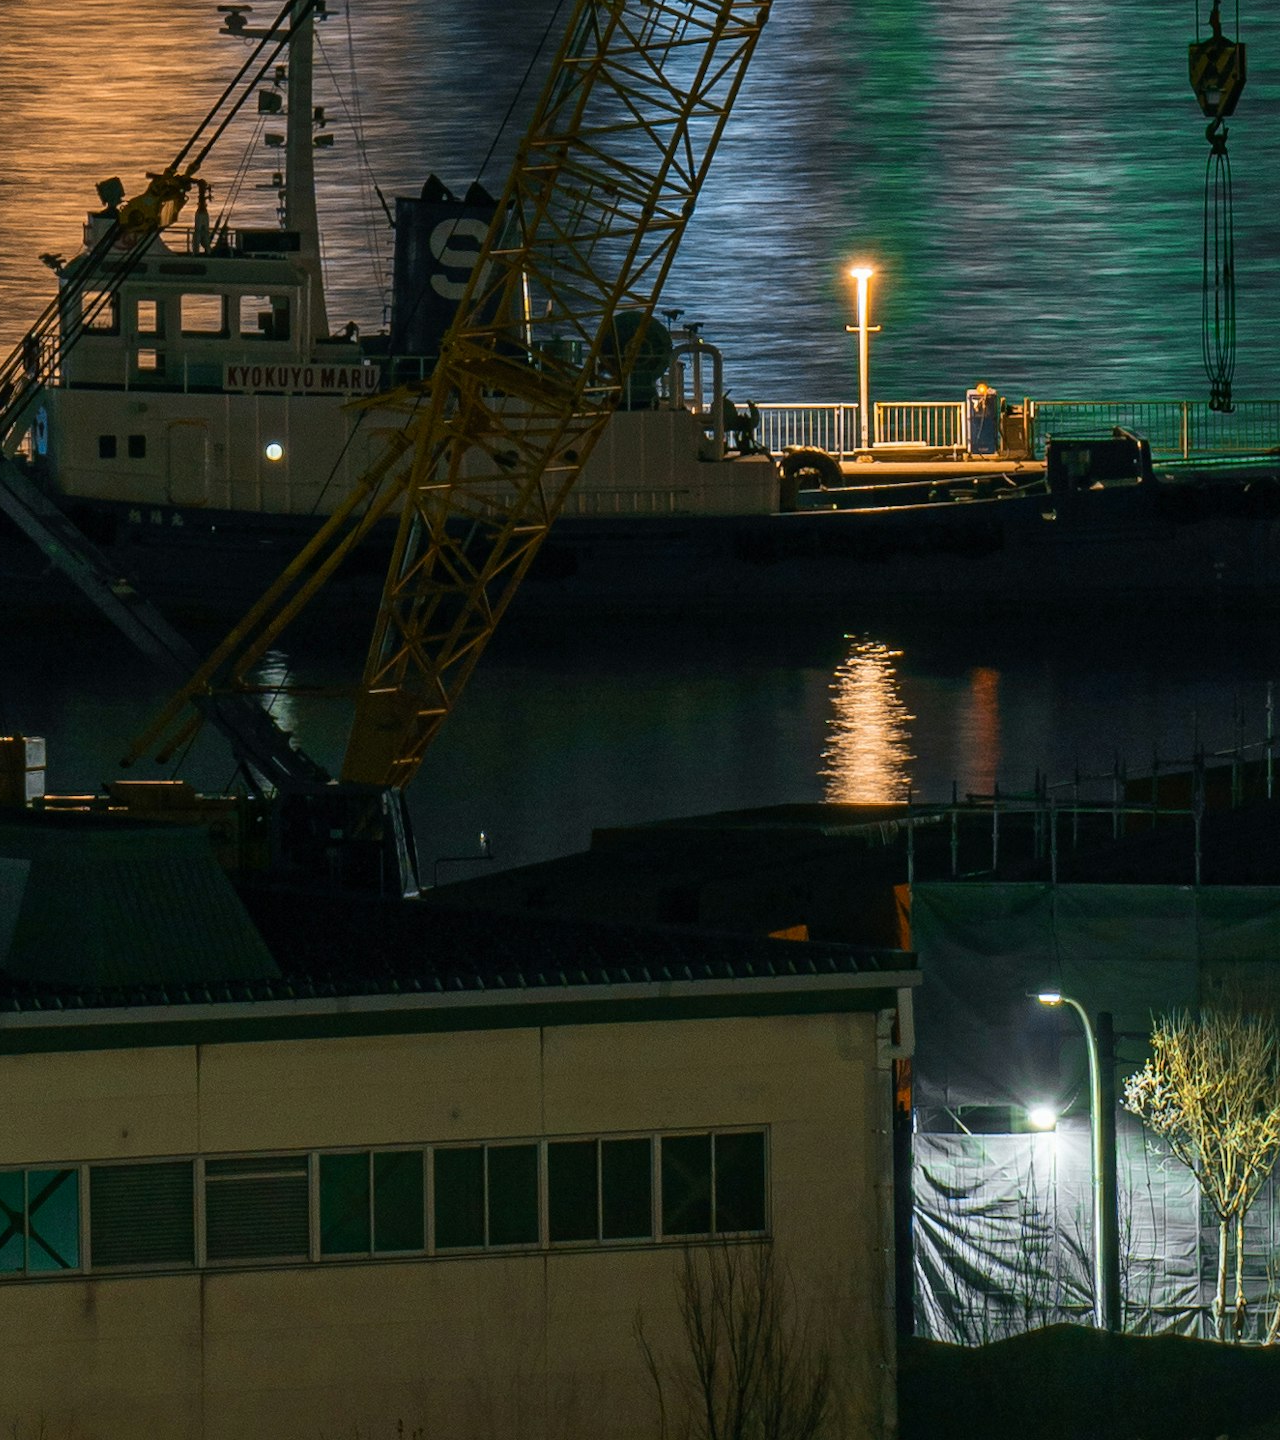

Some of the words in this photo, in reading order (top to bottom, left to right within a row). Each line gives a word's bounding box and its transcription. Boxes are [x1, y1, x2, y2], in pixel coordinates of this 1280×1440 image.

[429, 218, 494, 301] S
[227, 366, 314, 388] KYOKUYO
[319, 367, 376, 389] MARU
